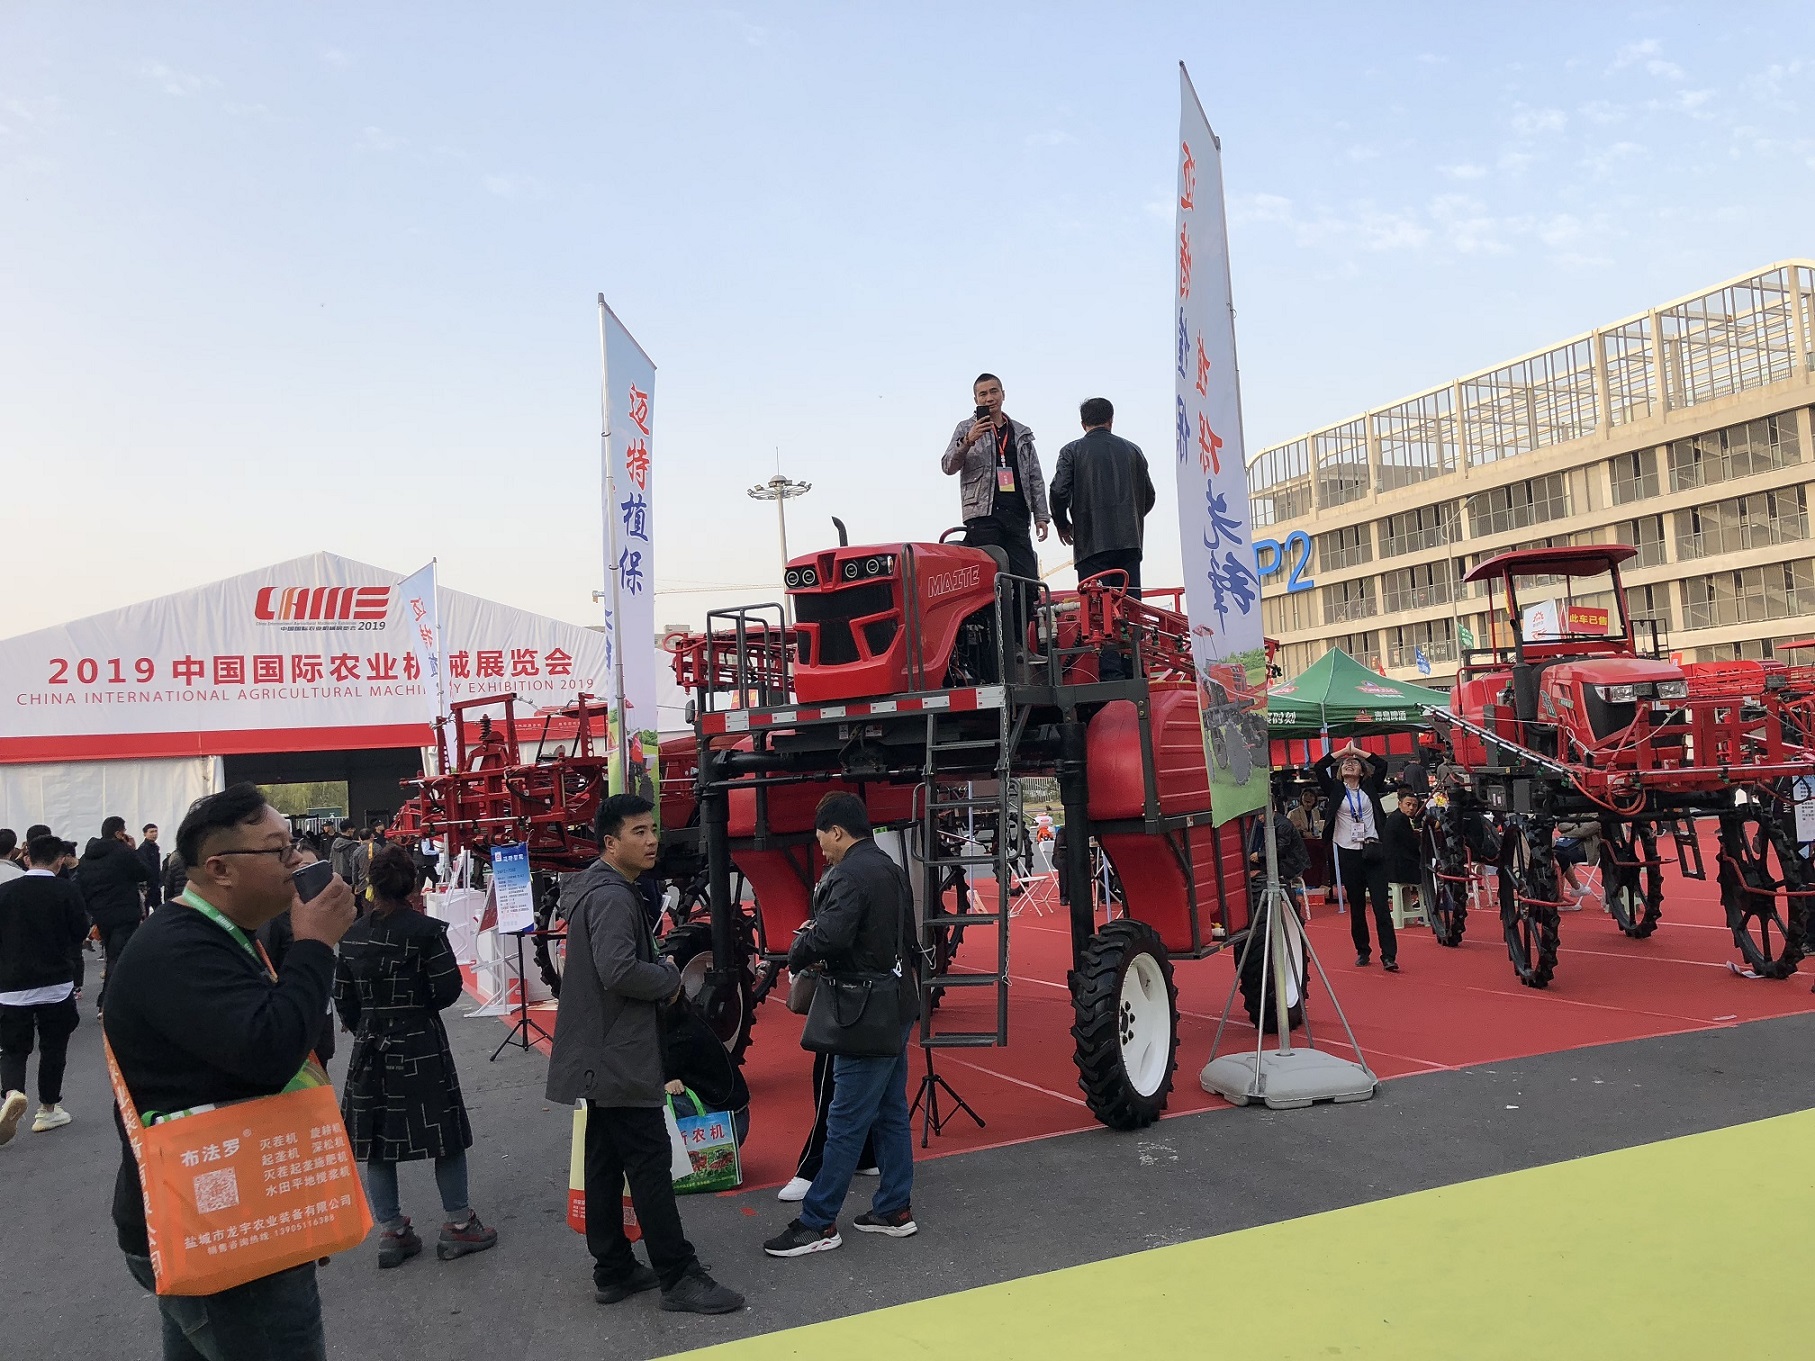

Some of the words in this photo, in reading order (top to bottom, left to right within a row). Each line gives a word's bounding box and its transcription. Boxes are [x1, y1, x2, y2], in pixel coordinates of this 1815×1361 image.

[619, 382, 650, 596] 迈特植保
[1253, 530, 1314, 593] P2
[358, 621, 386, 631] 2019
[1569, 613, 1607, 626] 此车已售
[48, 657, 155, 684] 2019
[172, 647, 573, 686] 中国国际农业机械展览会
[17, 693, 77, 706] CHINA
[85, 689, 229, 705] INTERNATIONAL
[237, 686, 363, 700] AGRICULTURAL
[370, 682, 462, 697] MACHIY
[469, 679, 554, 694] EXHIBITION
[560, 678, 594, 690] 2019
[180, 1138, 240, 1167] 布法罗
